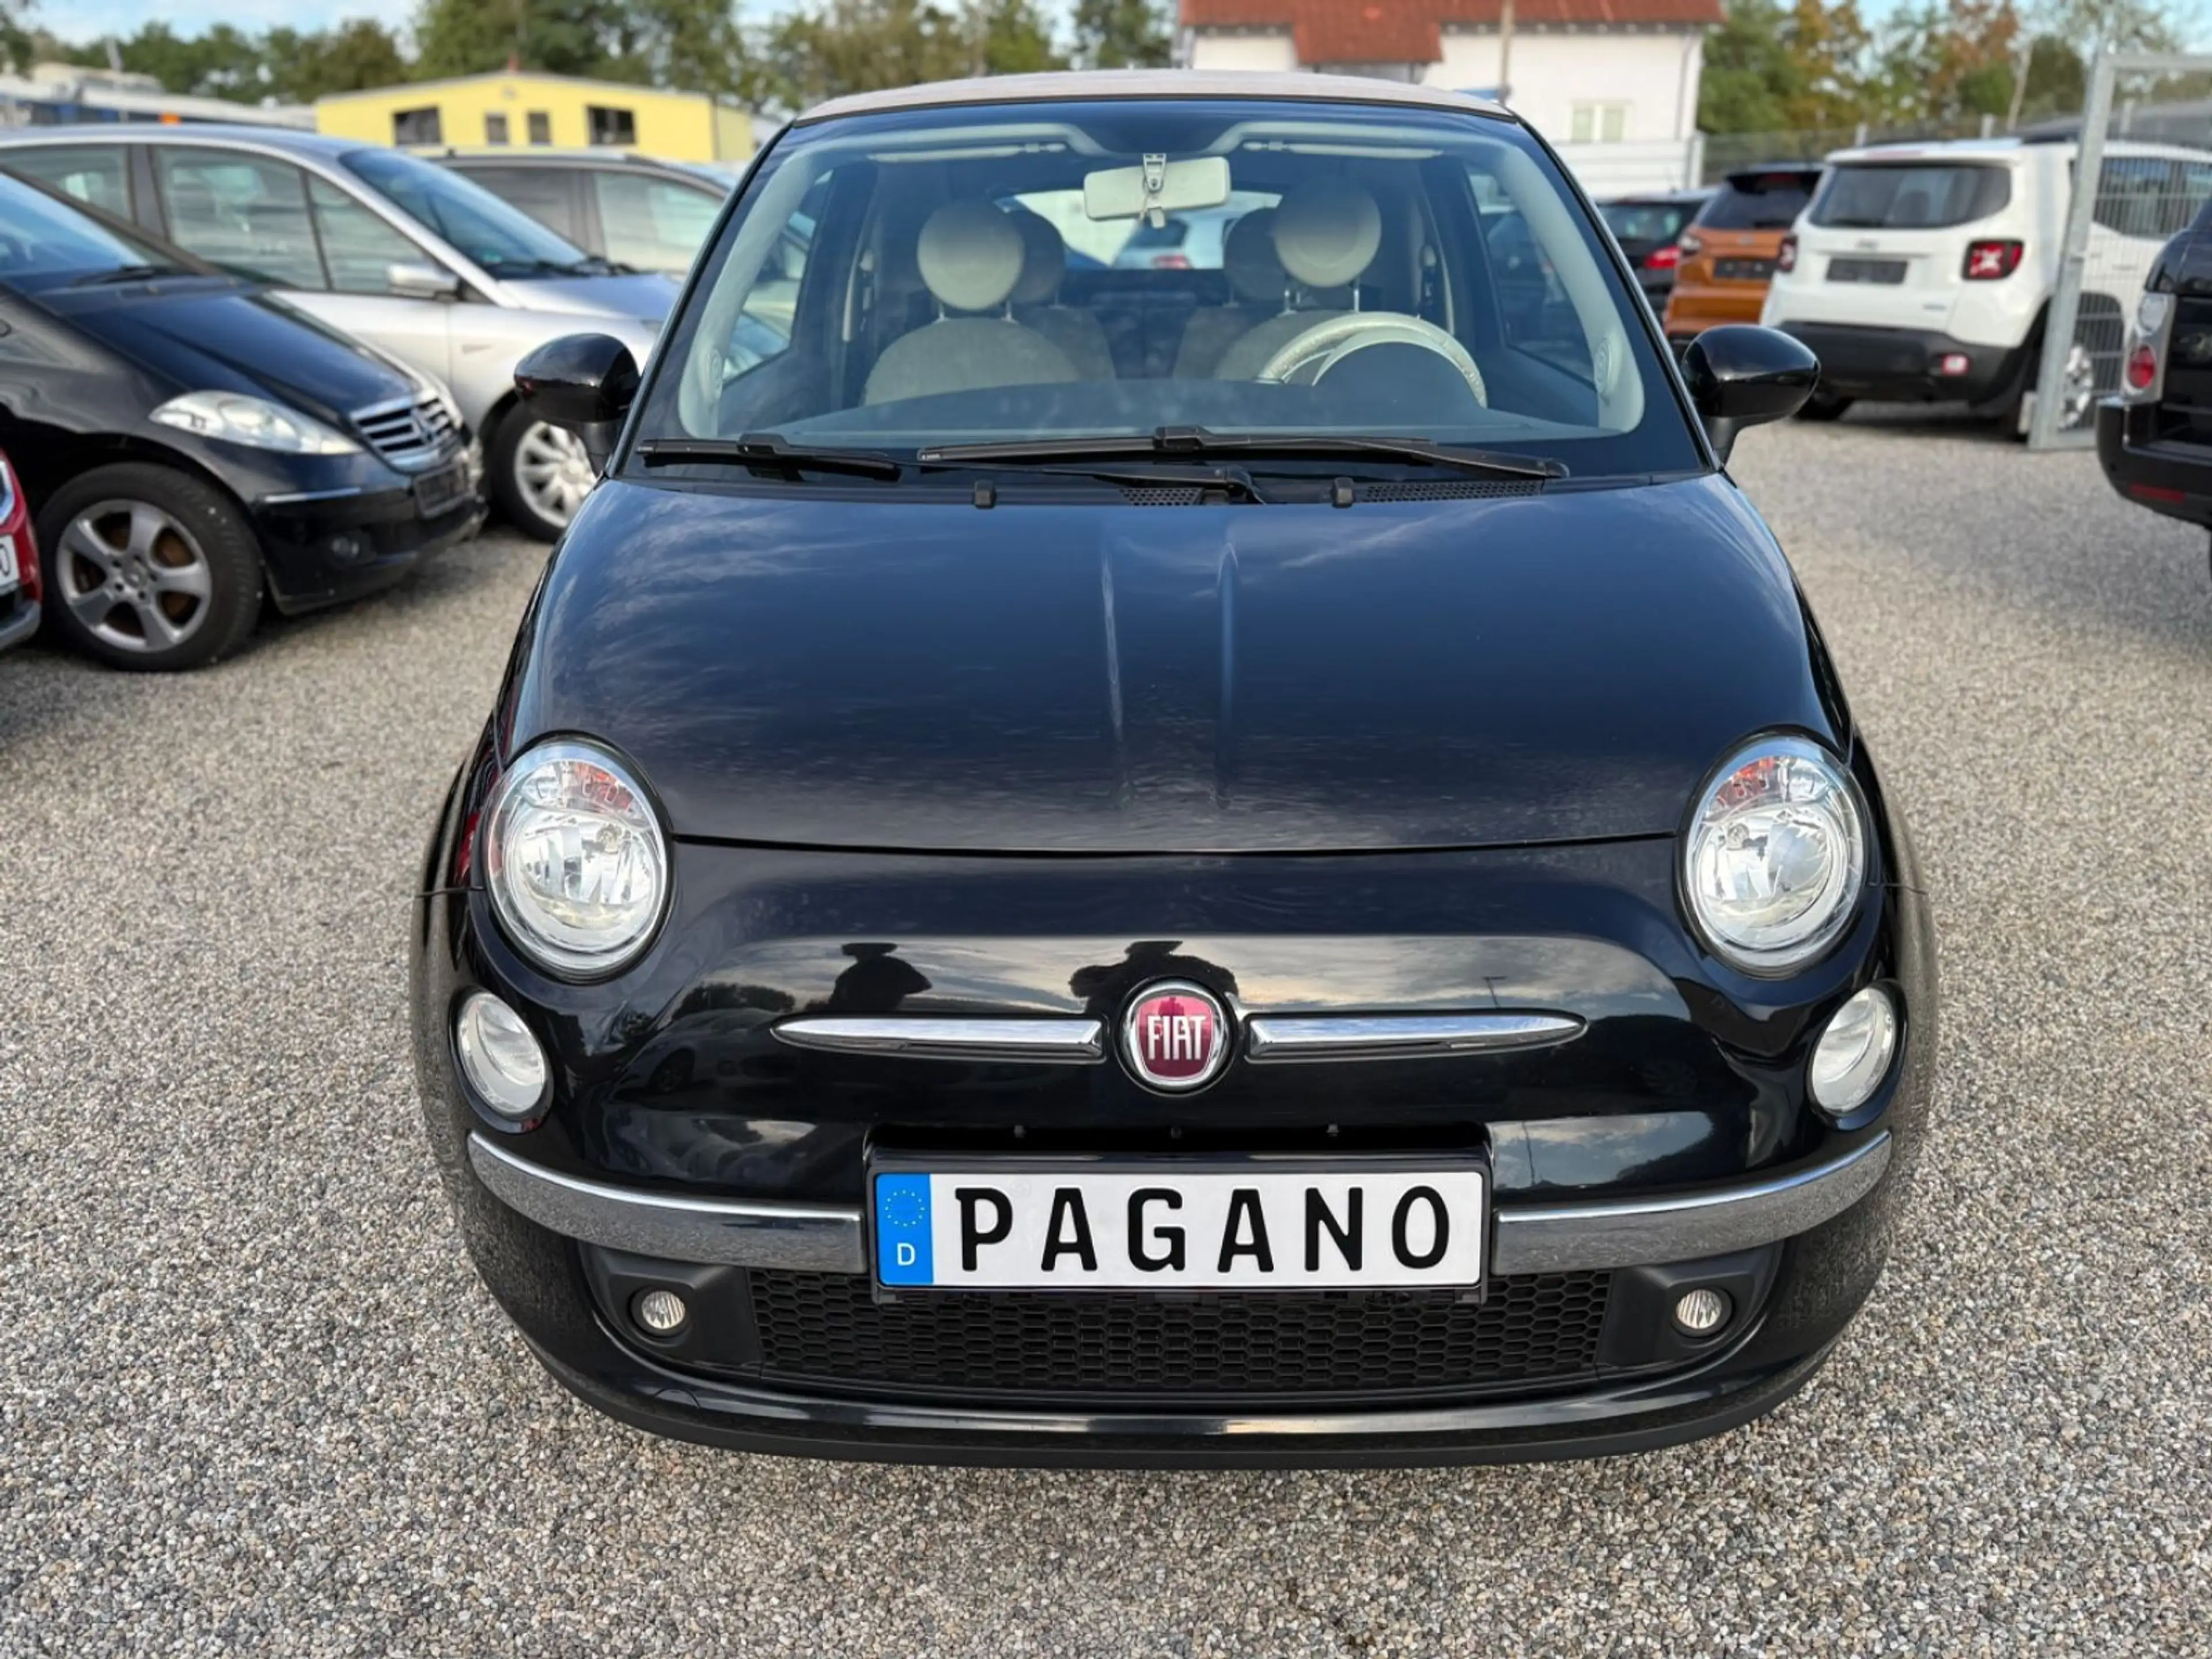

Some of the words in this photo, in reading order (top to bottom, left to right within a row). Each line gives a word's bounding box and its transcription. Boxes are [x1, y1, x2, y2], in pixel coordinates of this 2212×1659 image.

[1147, 1015, 1207, 1060] FIAT
[955, 1185, 1450, 1272] PAGANO
[897, 1243, 916, 1266] D
